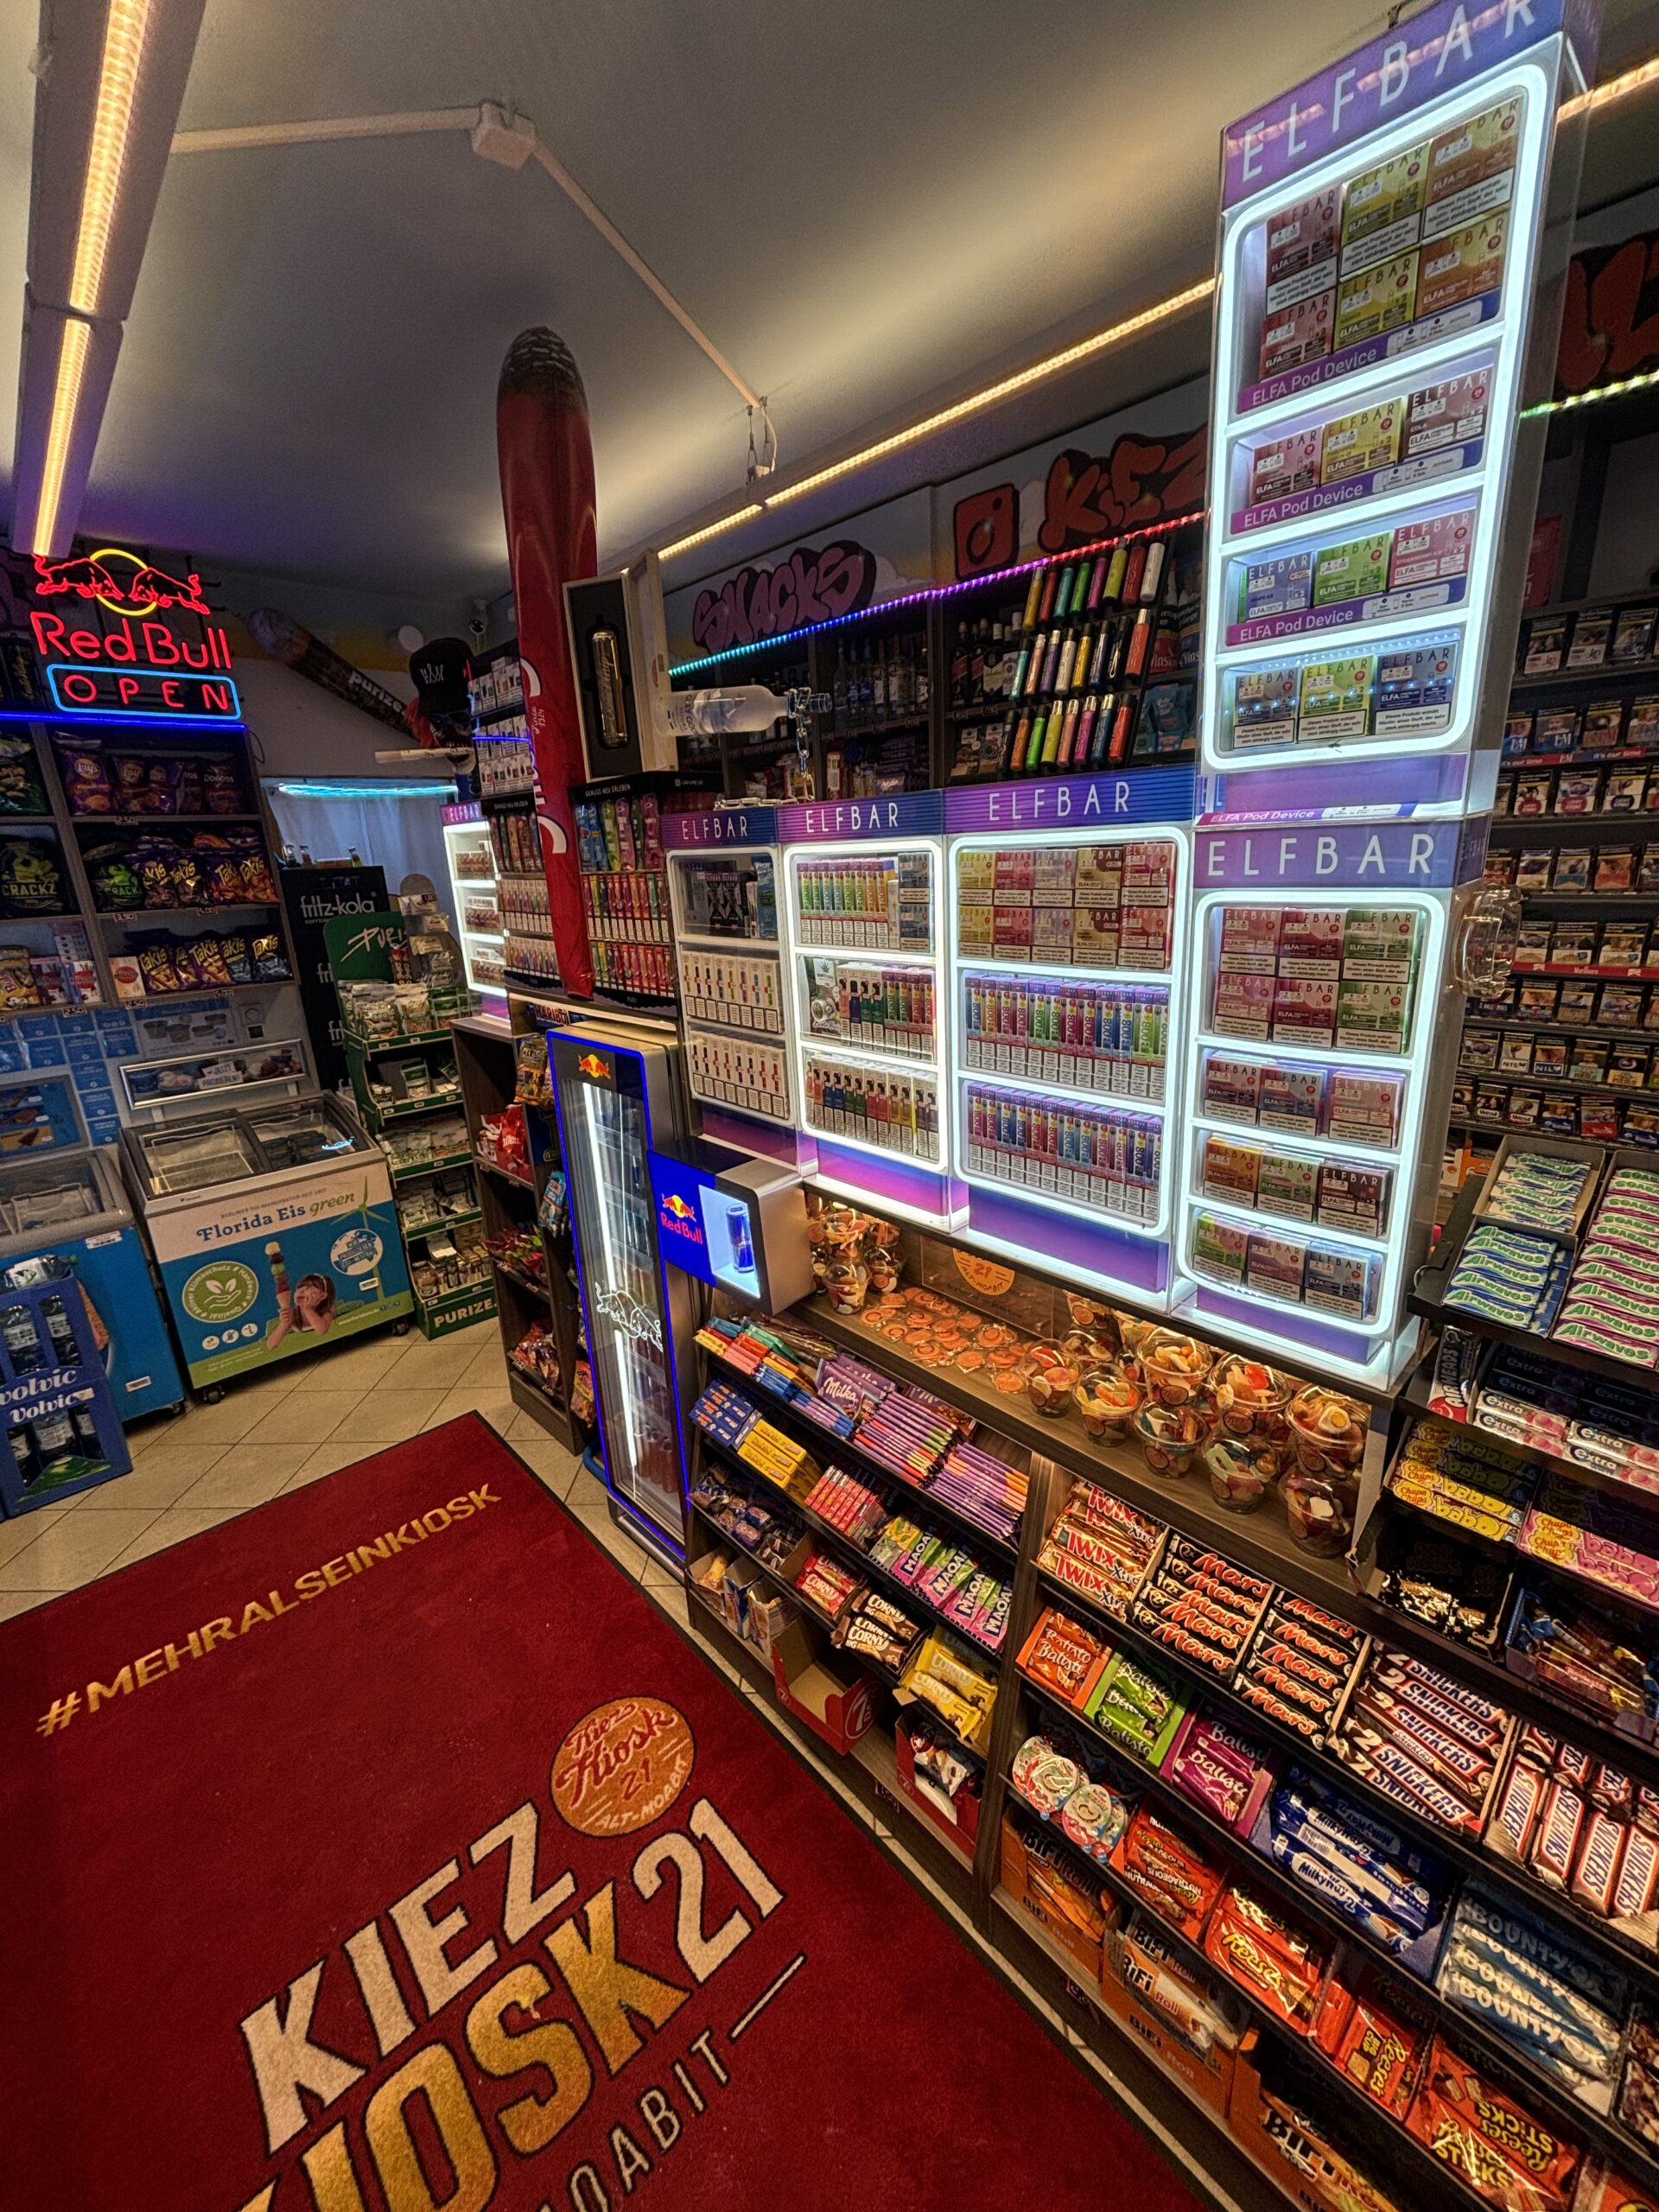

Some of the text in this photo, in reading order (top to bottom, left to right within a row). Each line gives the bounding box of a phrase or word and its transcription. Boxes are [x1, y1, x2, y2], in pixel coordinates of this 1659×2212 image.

[1243, 0, 1536, 181] ELFBAR
[1253, 348, 1379, 405] ELFA Pod Device
[1413, 370, 1488, 406] ELFBAR
[1243, 483, 1363, 528] ELFA Pod Device
[1249, 555, 1308, 580] ELFBAR
[1395, 566, 1415, 576] ELFA
[1319, 586, 1338, 595] ELFA
[30, 612, 232, 669] Red Bull
[1240, 609, 1353, 642] ELFA Pod Device
[64, 675, 228, 710] OPEN
[585, 788, 601, 797] GENUSS
[611, 784, 631, 792] ERLEBEN
[988, 781, 1131, 821] ELFBAR
[682, 816, 748, 840] ELFBAR
[805, 803, 899, 833] ELFBAR
[1210, 808, 1314, 823] ELFA Pod Device
[1208, 833, 1435, 876] ELFBAR
[2, 882, 57, 895] CRACKZ
[104, 885, 138, 896] CRACK
[301, 893, 375, 918] fritz-kola
[139, 945, 168, 972] Takis
[189, 940, 219, 966] Takis
[340, 927, 407, 963] PURI
[1323, 1168, 1379, 1186] ELFBAR
[196, 1192, 355, 1242] Florida Eis green
[660, 1212, 703, 1245] Red Bull
[1465, 1236, 1545, 1264] Airwaves
[974, 1262, 992, 1278] 21
[1459, 1253, 1541, 1283] Airwaves
[1452, 1271, 1533, 1303] Airwaves
[434, 1298, 498, 1327] PURIZE.
[1444, 1288, 1526, 1323] Airwaves
[1561, 1303, 1657, 1338] Airwaves
[1555, 1324, 1649, 1361] Airwaves
[823, 1375, 856, 1401] Milka
[1483, 1394, 1524, 1414] extra
[1481, 1414, 1521, 1435] extra
[1580, 1424, 1624, 1449] extra
[1573, 1444, 1617, 1468] extra
[805, 1573, 839, 1599] CORNY
[1193, 1553, 1271, 1598] Mars
[35, 1483, 502, 1737] #MEHRALSEINKIOSK
[868, 1594, 906, 1623] CORNY
[1161, 1601, 1243, 1649] Mars
[848, 1627, 889, 1650] CORNY
[1152, 1622, 1235, 1670] Mars
[1274, 1622, 1348, 1665] Mars
[1262, 1643, 1338, 1689] Mars
[1242, 1687, 1318, 1735] Mars
[1402, 1681, 1492, 1743] SNICKERS
[1395, 1707, 1478, 1771] SNICKERS
[594, 1753, 688, 1829] ALT-MOABIT
[619, 1758, 652, 1802] 21
[1376, 1748, 1465, 1821] SNICKERS
[1545, 1787, 1582, 1869] SNICKERS
[1582, 1815, 1621, 1896] SNICKERS
[1617, 1834, 1656, 1917] SNICKERS
[239, 1802, 576, 2154] KIEZ
[238, 1796, 785, 2212] IOSK 21
[534, 2030, 730, 2212] OABIT
